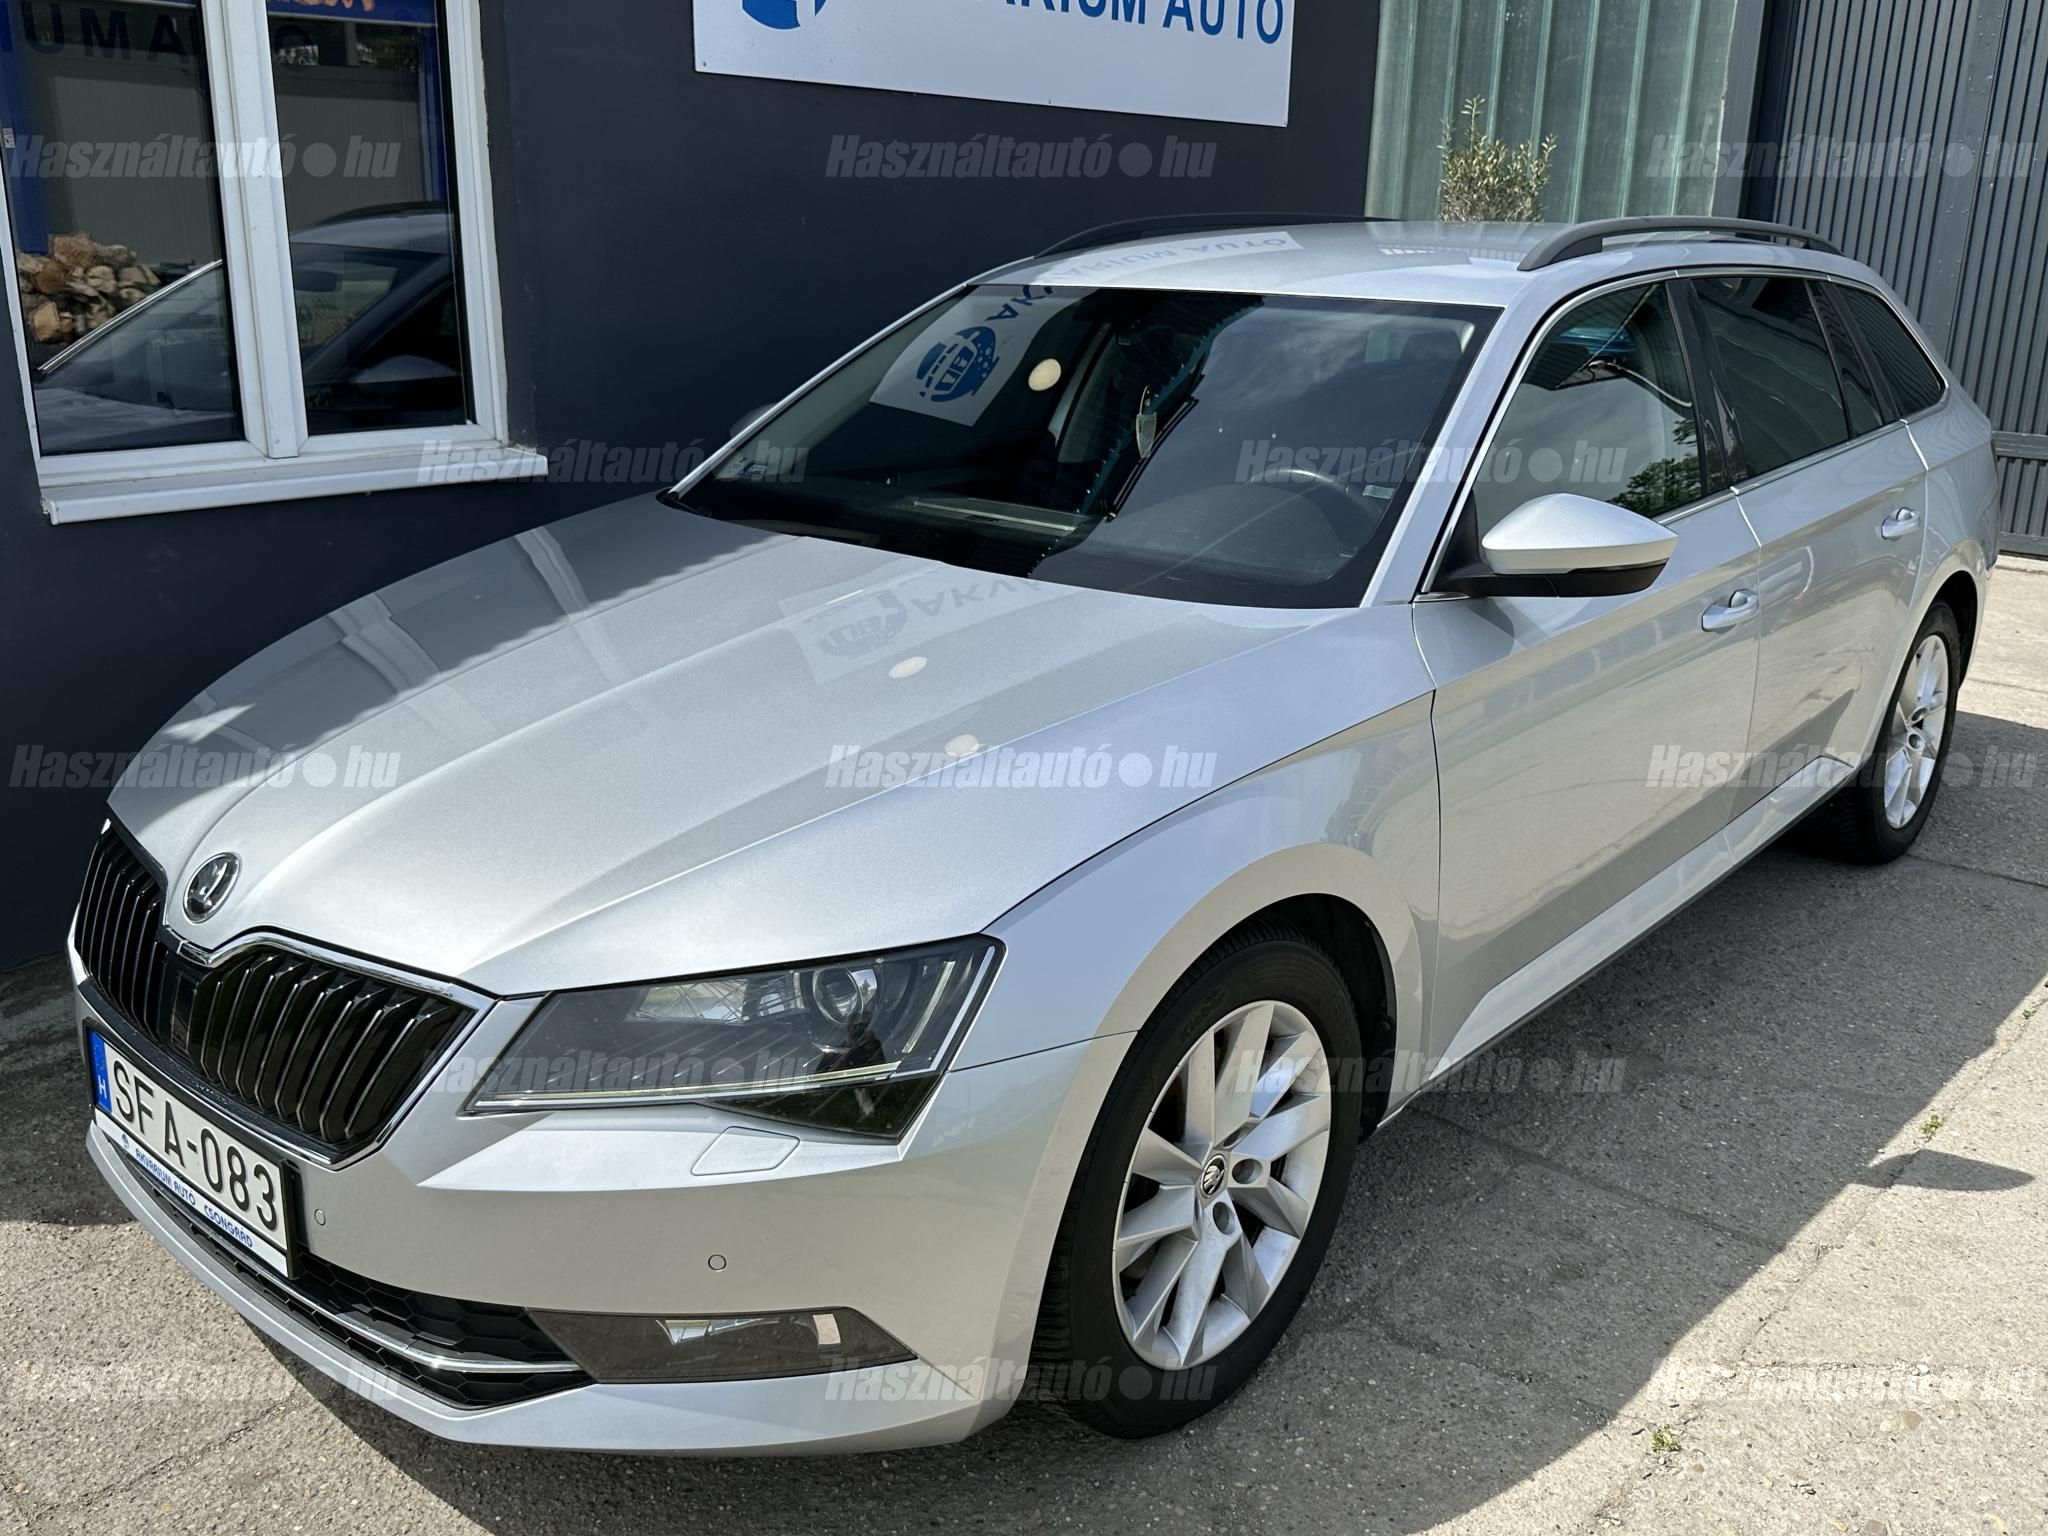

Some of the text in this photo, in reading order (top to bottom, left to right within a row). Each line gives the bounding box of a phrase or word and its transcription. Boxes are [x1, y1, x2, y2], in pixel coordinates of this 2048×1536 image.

[97, 1075, 108, 1100] H
[113, 1060, 278, 1230] SFA-083
[203, 1203, 254, 1247] CSONGRÁD
